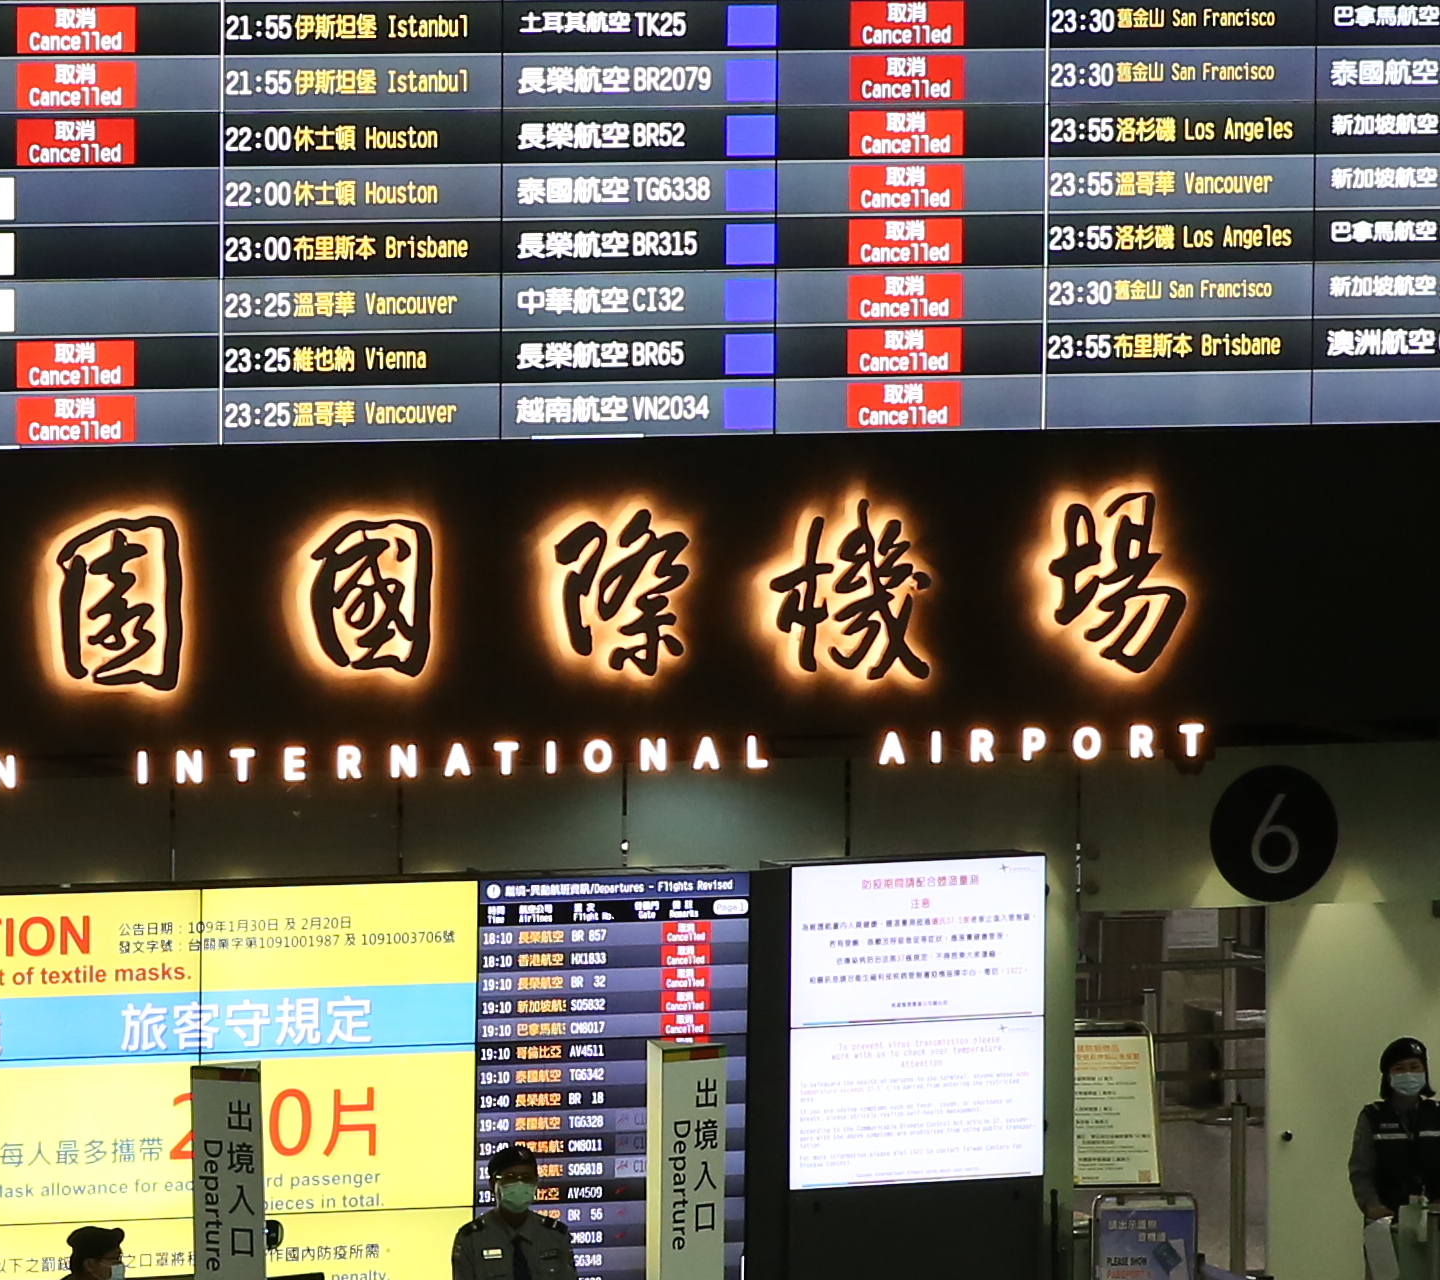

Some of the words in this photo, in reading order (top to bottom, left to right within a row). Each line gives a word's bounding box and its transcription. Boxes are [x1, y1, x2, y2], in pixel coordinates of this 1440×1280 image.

[137, 735, 768, 784] INTERNATIONAL
[879, 723, 1204, 765] AIRPORT
[1251, 794, 1299, 874] 6
[658, 881, 694, 892] Flights
[697, 880, 732, 891] Revised
[483, 932, 512, 944] 18:10
[667, 932, 705, 942] Cancelled
[483, 955, 512, 967] 18:10
[666, 955, 705, 965] Cancelled
[12, 967, 34, 985] of
[40, 965, 107, 984] textile
[115, 964, 191, 981] masks.
[121, 996, 371, 1052] 旅客守規定
[480, 1046, 510, 1060] 19:10
[570, 1044, 604, 1058] AV4511
[693, 1077, 718, 1233] 出境入口
[43, 1180, 127, 1196] allowance
[135, 1179, 158, 1194] for
[291, 1173, 380, 1189] passenger
[227, 1100, 255, 1258] 出境入口
[668, 1120, 691, 1251] Departure
[199, 1140, 224, 1272] Departure
[321, 1195, 336, 1208] in
[342, 1192, 384, 1207] total.
